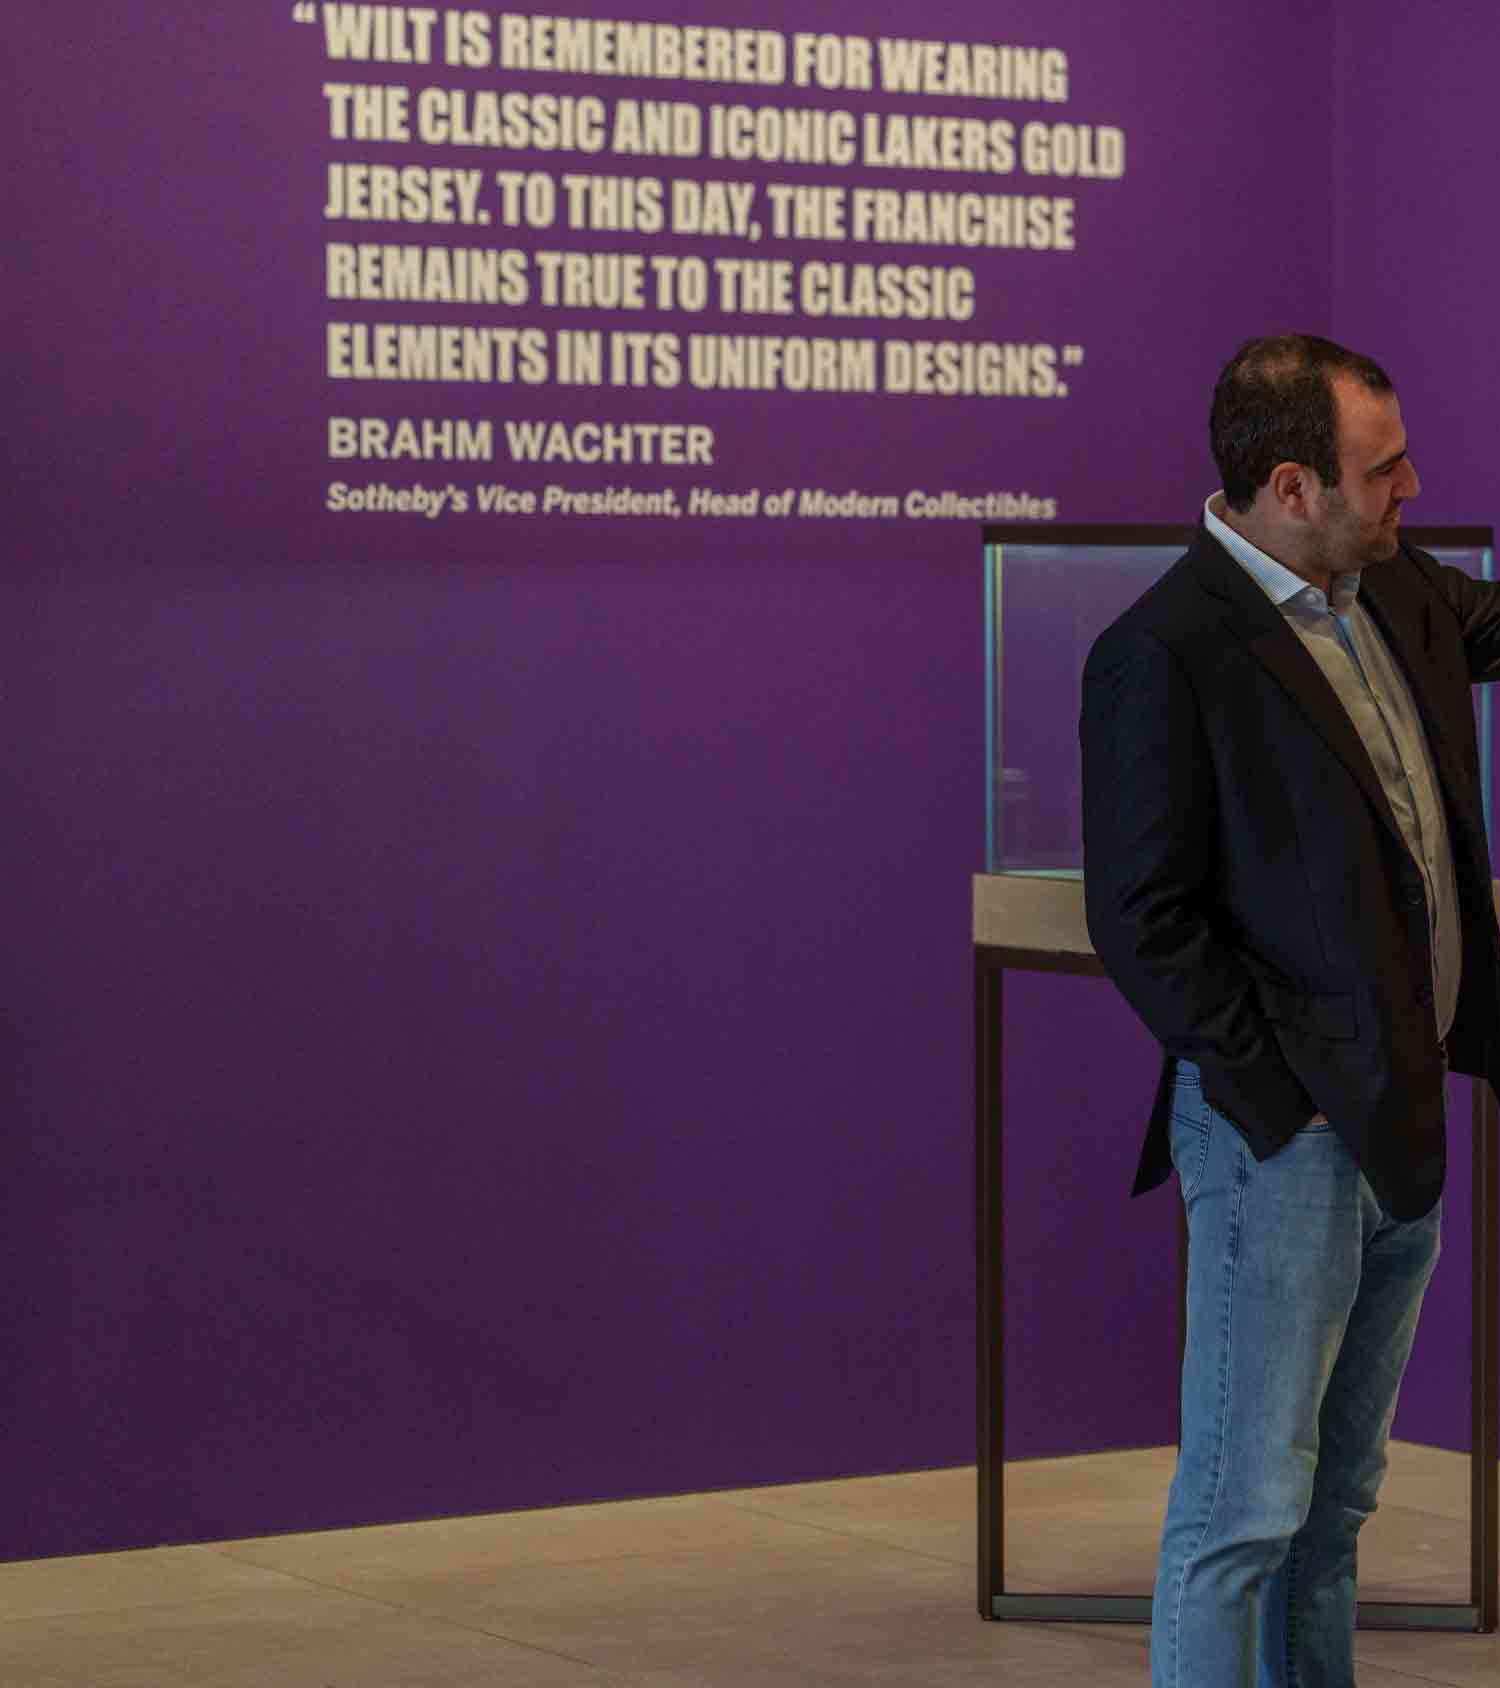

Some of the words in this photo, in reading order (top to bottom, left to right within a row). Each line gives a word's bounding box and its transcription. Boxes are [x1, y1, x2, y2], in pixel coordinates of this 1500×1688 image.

[445, 10, 492, 68] IS
[499, 13, 786, 84] REMEMBERED
[793, 32, 872, 90] FOR
[878, 38, 1068, 102] WEARING
[323, 83, 410, 143] THE
[418, 87, 605, 153] CLASSIC
[612, 99, 701, 157] AND
[710, 104, 856, 165] ICONIC
[864, 113, 1016, 174] LAKERS
[1022, 122, 1124, 178] GOLD
[324, 163, 490, 224] JERSEY.
[496, 171, 555, 228] TO
[562, 174, 664, 233] THIS
[672, 180, 761, 241] DAY,
[767, 184, 846, 240] THE
[853, 188, 1074, 250] FRANCHISE
[326, 243, 528, 305] REMAINS
[535, 251, 645, 309] TRUE
[651, 256, 707, 312] TO
[714, 259, 793, 314] THE
[801, 261, 974, 320] CLASSIC
[327, 323, 548, 384] ELEMENTS
[557, 330, 602, 385] IN
[611, 332, 681, 387] ITS
[689, 334, 876, 392] UNIFORM
[329, 418, 492, 460] BRAHM
[506, 422, 713, 464] WACHTER
[326, 483, 468, 518] Sotheby's
[478, 485, 536, 513] Vice
[543, 486, 680, 516] President,
[688, 488, 758, 516] Head
[763, 489, 795, 516] of
[799, 490, 898, 517] Modern
[904, 491, 1056, 518] Collectibles
